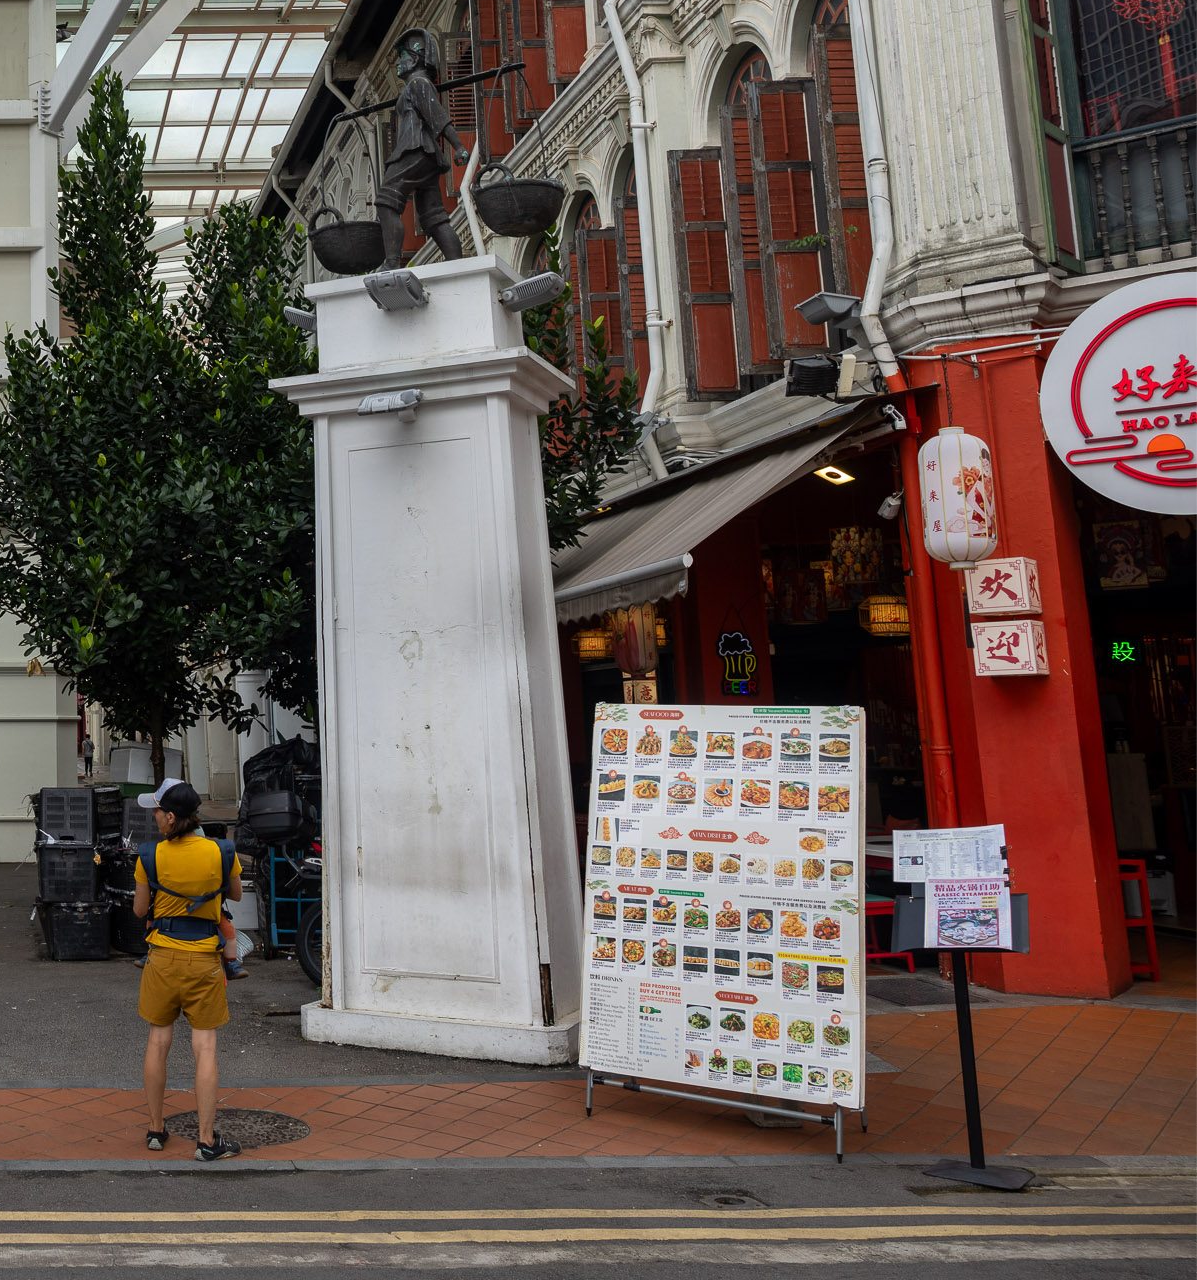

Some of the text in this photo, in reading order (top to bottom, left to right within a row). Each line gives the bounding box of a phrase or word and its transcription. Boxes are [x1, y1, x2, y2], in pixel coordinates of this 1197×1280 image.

[1122, 416, 1170, 432] HAO
[978, 569, 1018, 601] 欢
[986, 631, 1020, 665] 迎
[724, 681, 756, 693] BEER
[934, 883, 1000, 892] 精品火锅自助
